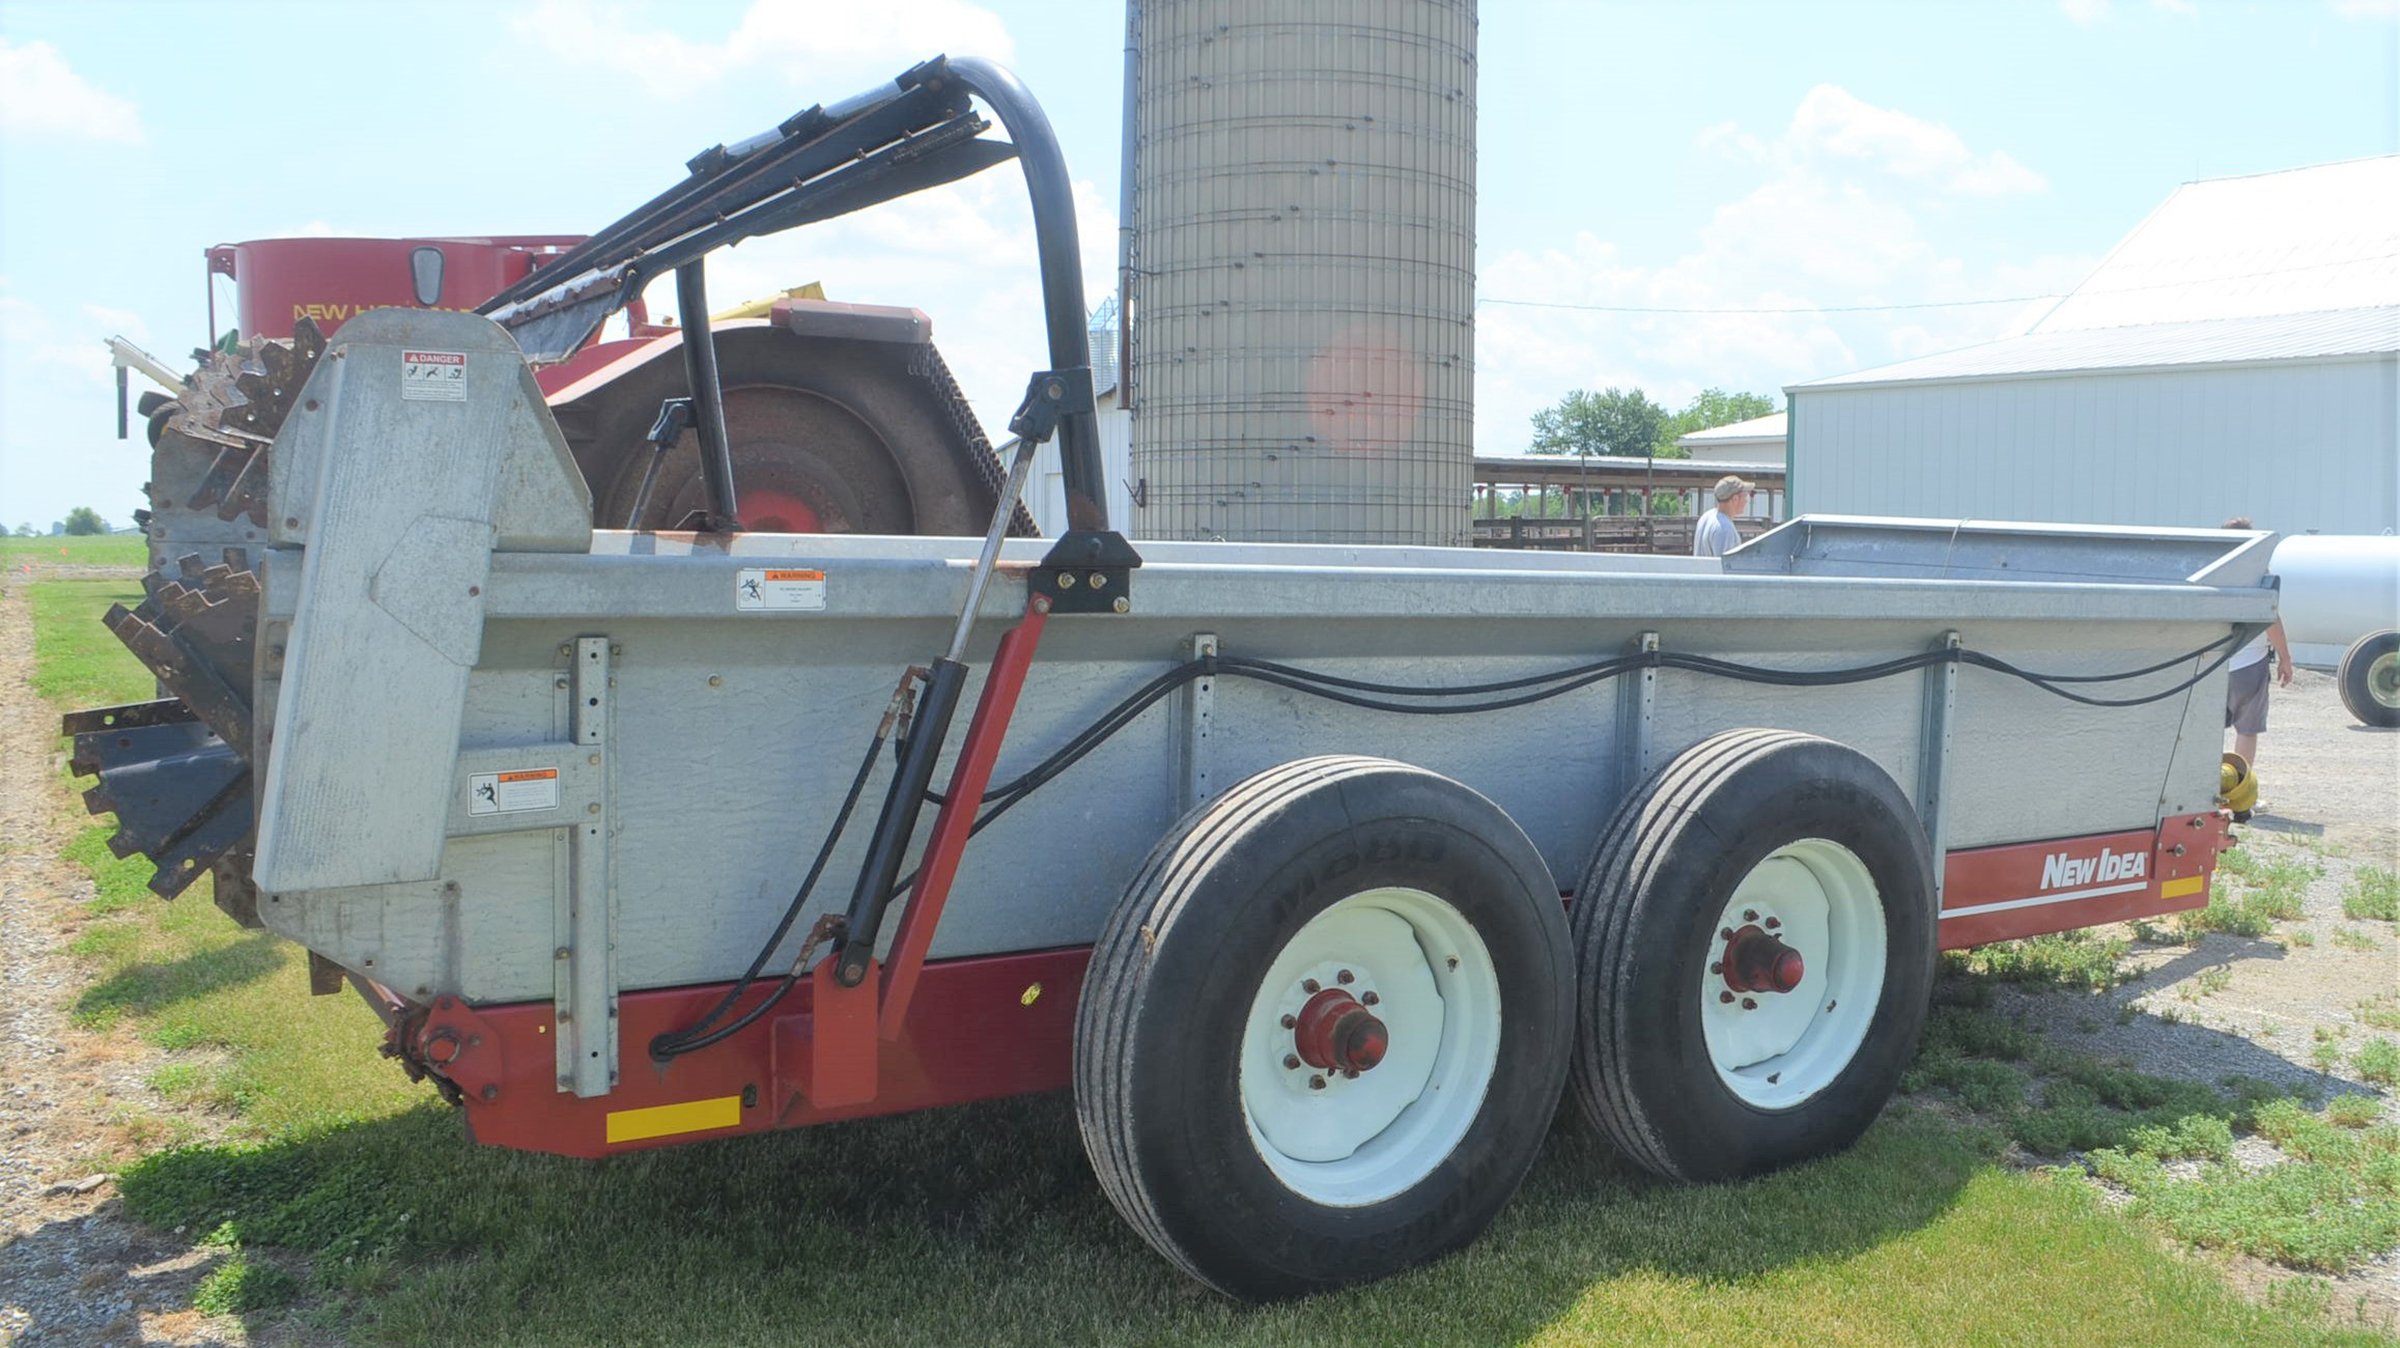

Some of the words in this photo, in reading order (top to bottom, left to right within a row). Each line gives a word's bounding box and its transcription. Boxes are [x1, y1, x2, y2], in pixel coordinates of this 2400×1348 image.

[293, 304, 348, 321] NEW
[419, 354, 460, 364] DANGER
[2040, 852, 2098, 890] NEW
[2096, 847, 2146, 883] IDEA
